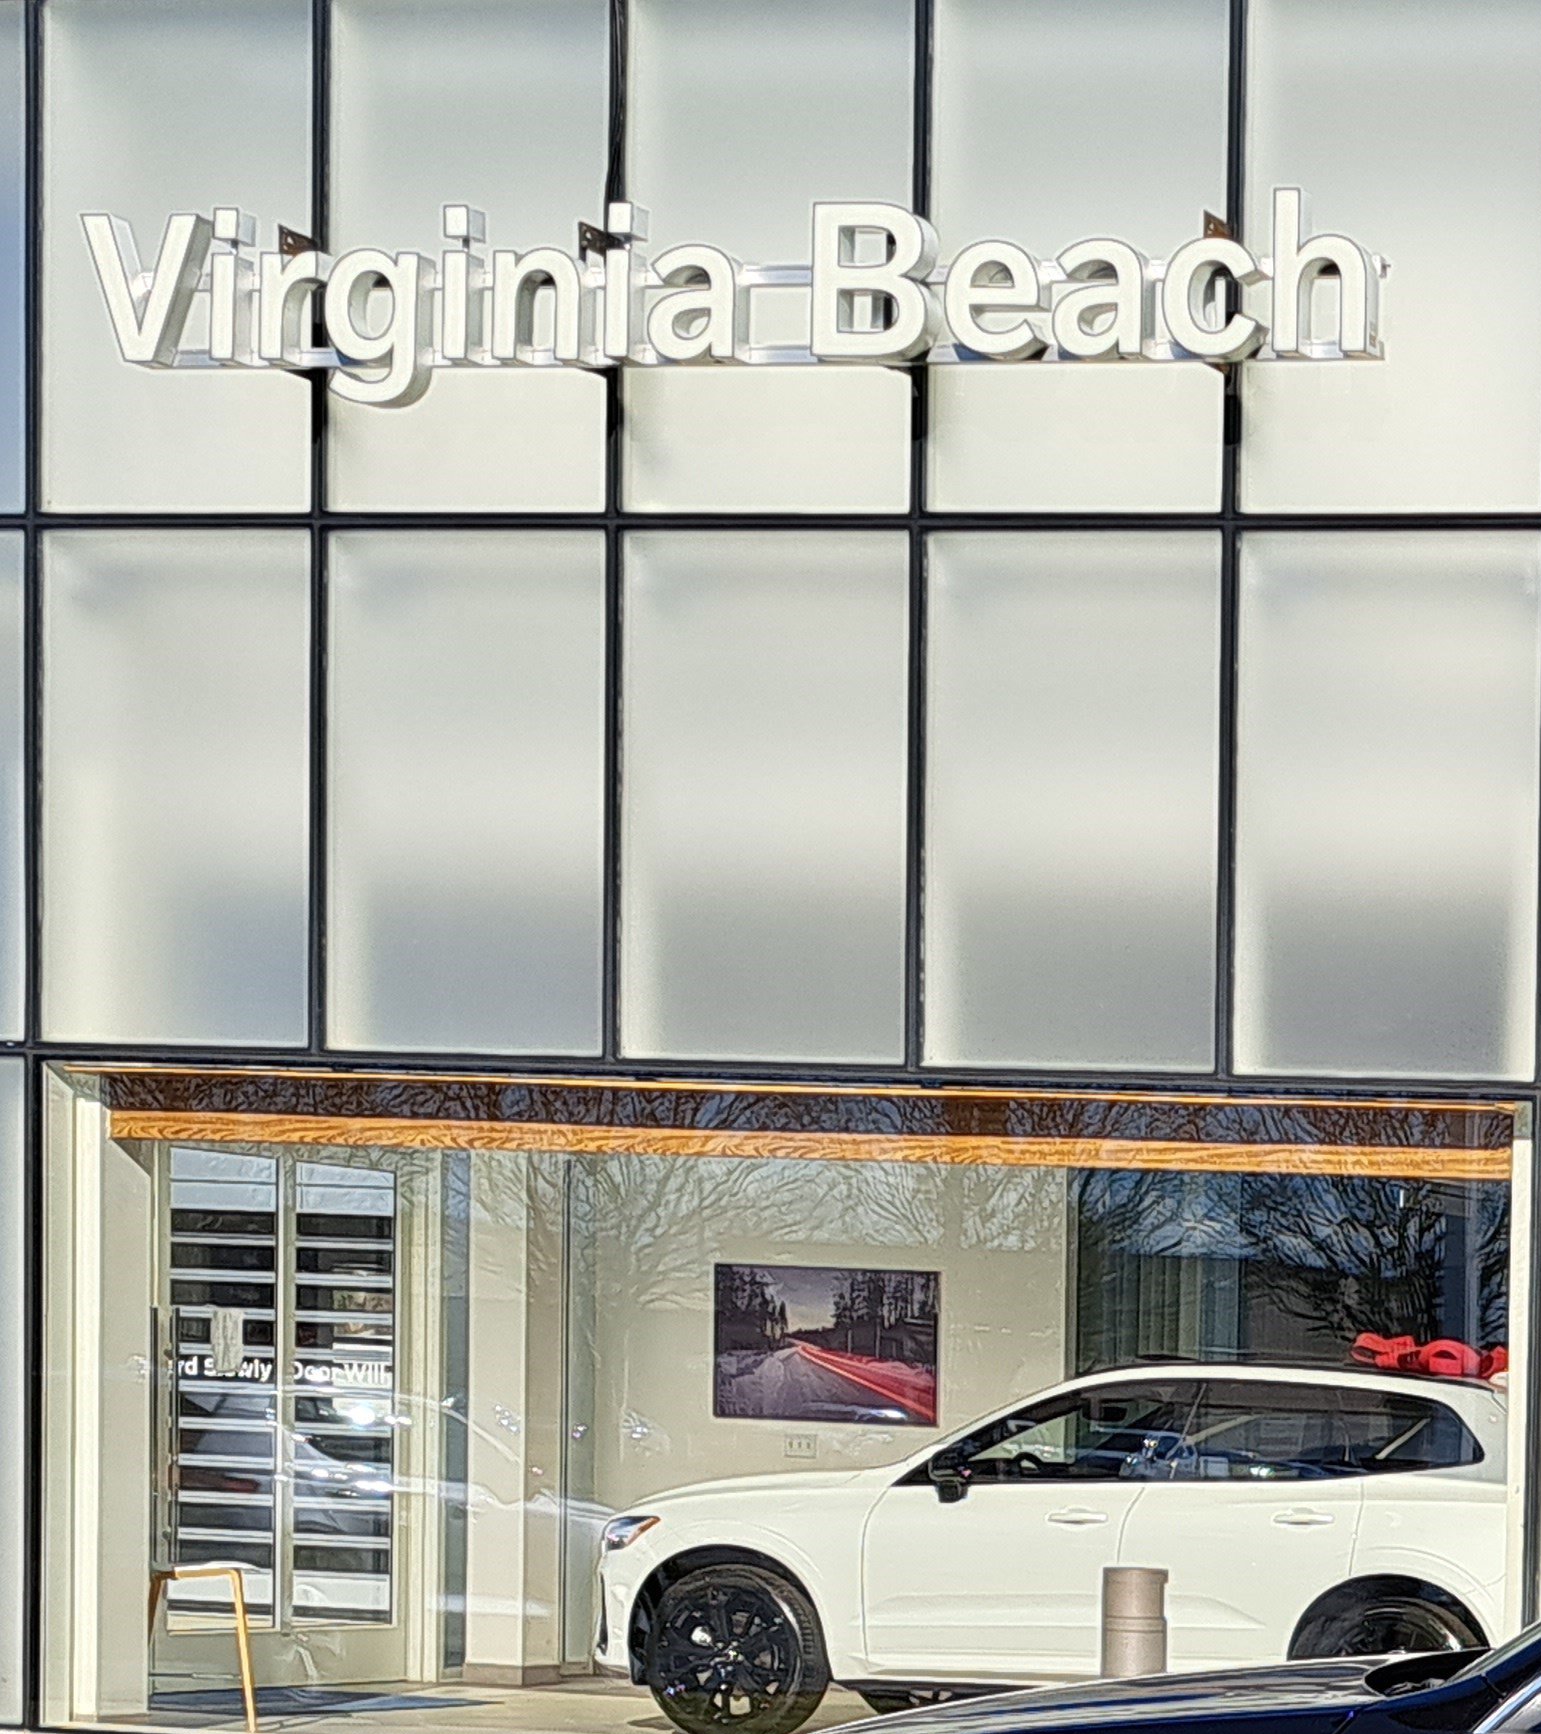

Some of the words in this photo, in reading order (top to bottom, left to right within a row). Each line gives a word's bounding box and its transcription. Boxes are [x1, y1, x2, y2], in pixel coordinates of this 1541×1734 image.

[80, 202, 746, 408] Virginia
[810, 186, 1386, 364] Beach
[203, 1357, 273, 1383] Swly
